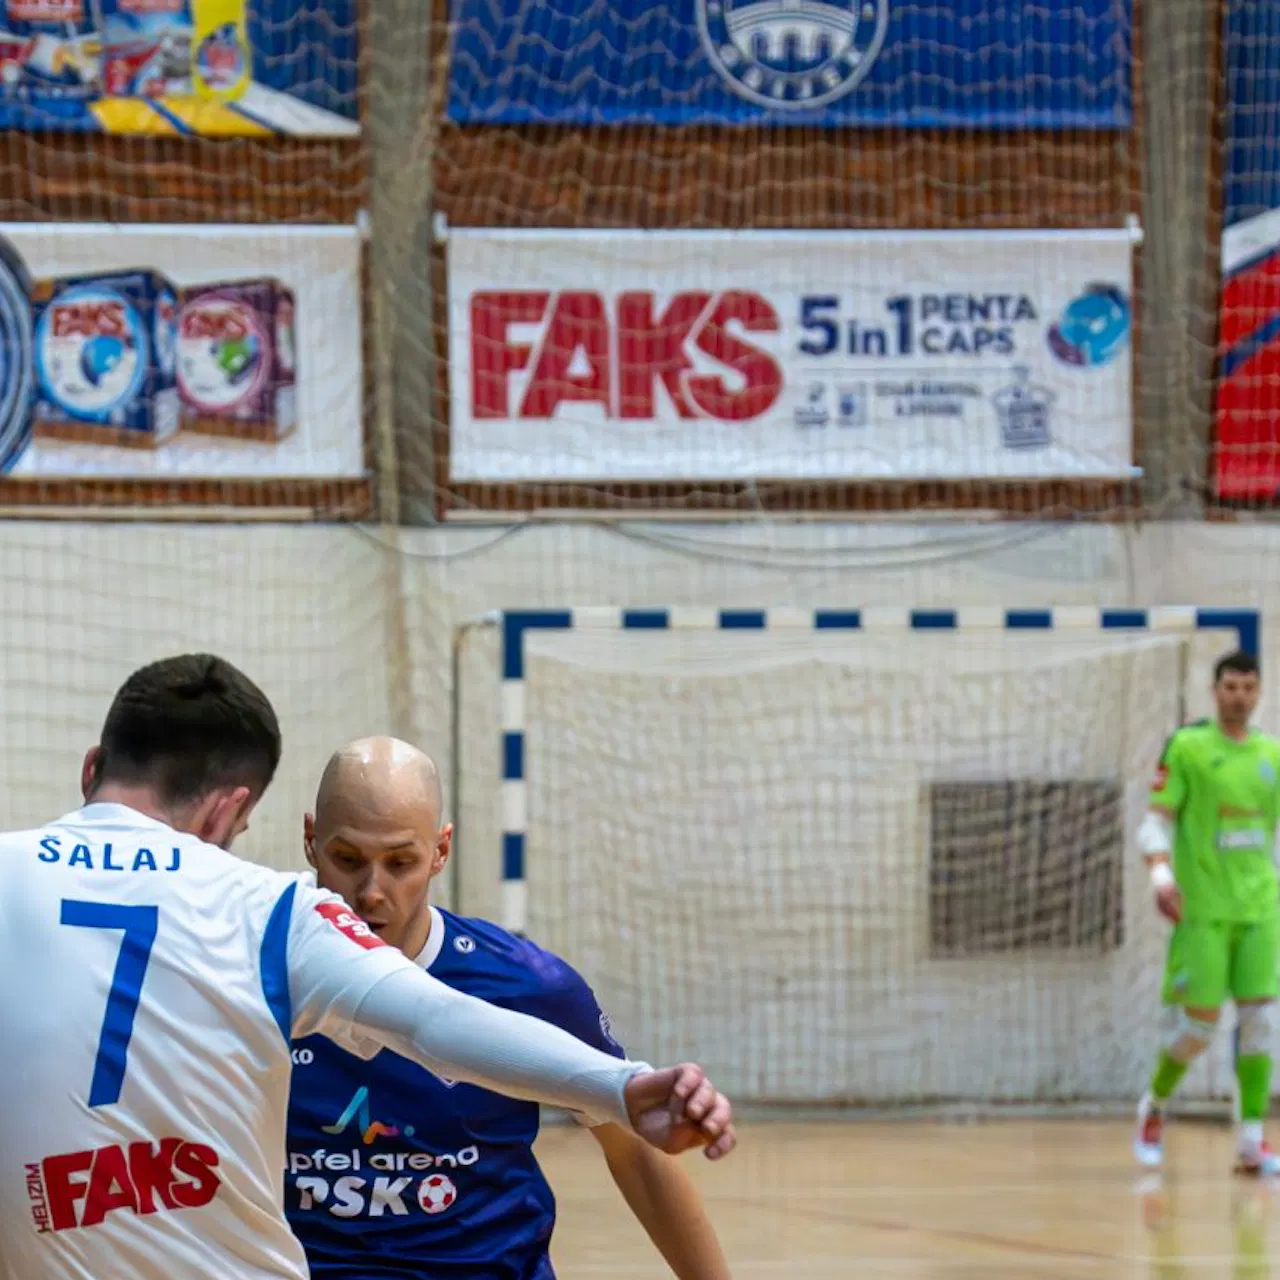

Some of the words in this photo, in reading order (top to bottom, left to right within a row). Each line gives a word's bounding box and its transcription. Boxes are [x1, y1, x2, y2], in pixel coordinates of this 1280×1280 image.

[921, 295, 1039, 321] PENTA
[470, 289, 783, 422] FAKS
[922, 327, 1014, 354] CAPS
[38, 834, 181, 871] ŠALAJ
[60, 899, 158, 1108] 7
[285, 1149, 360, 1174] pfel
[369, 1146, 480, 1171] arena
[43, 1137, 222, 1232] FAKS
